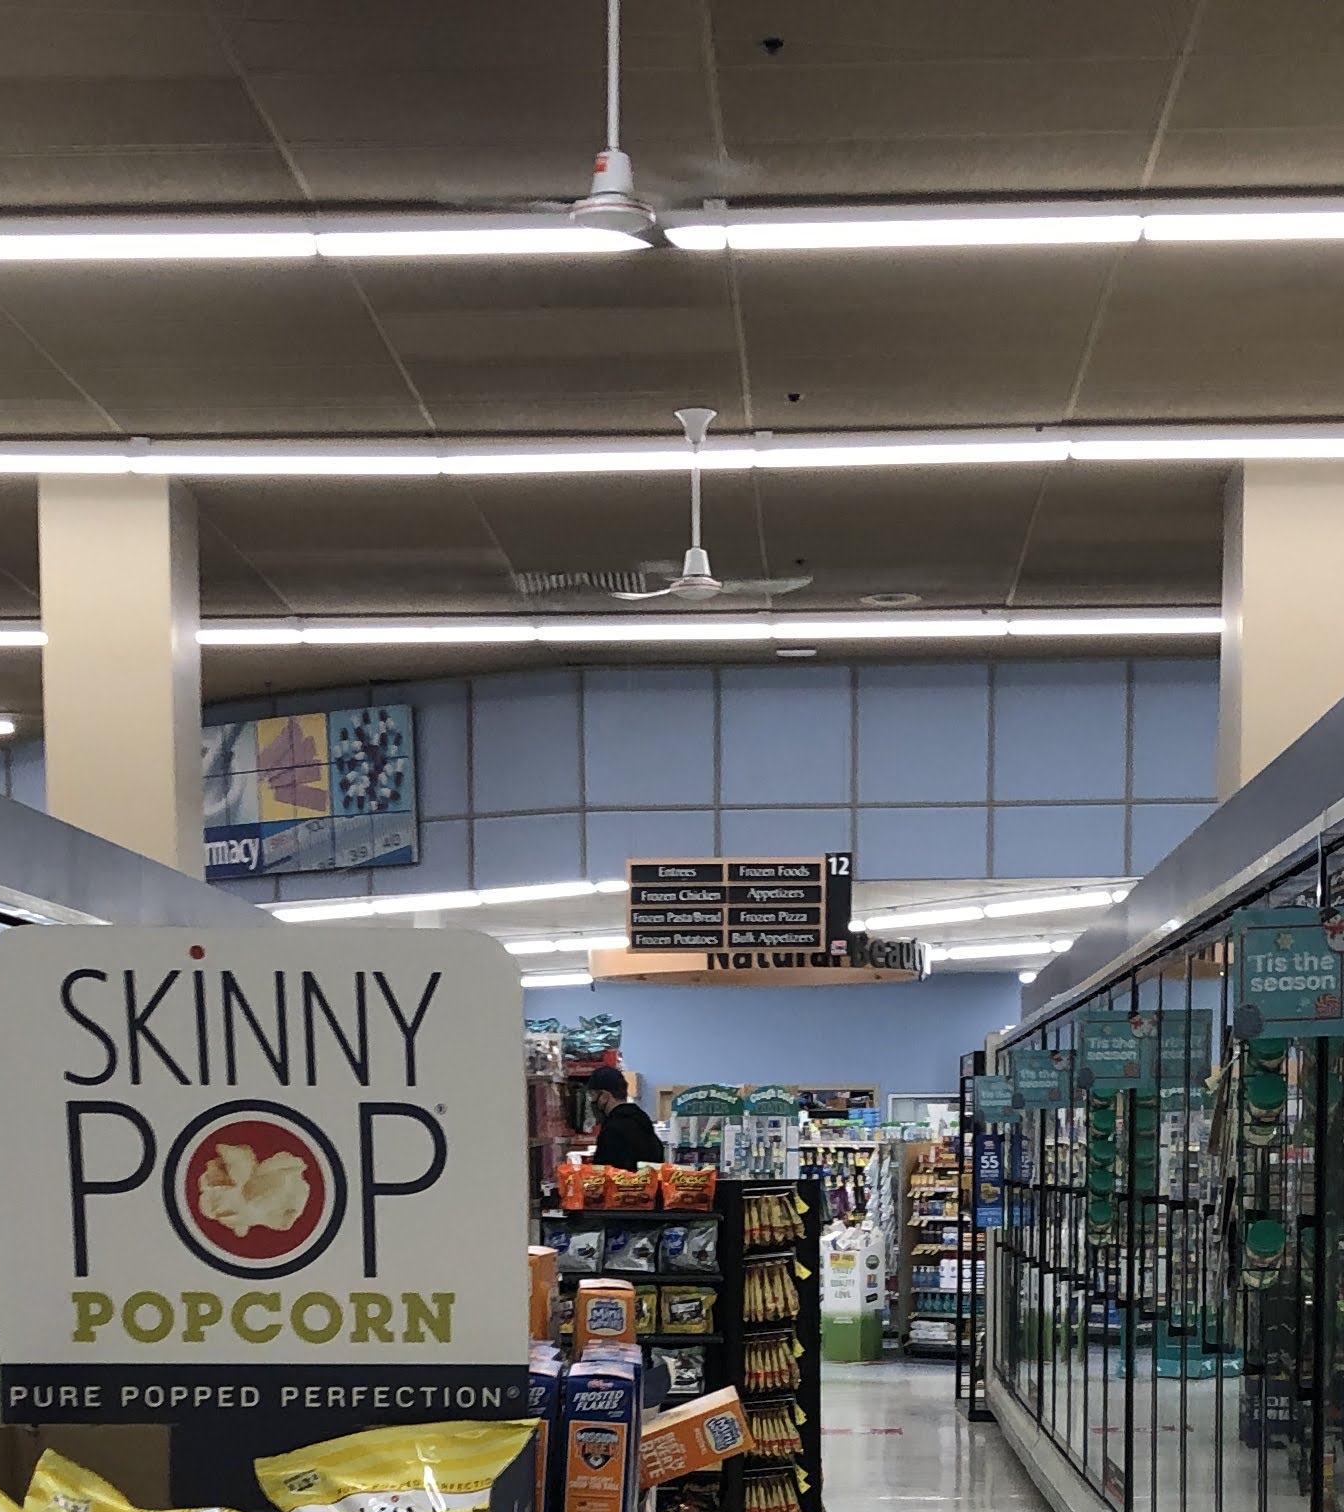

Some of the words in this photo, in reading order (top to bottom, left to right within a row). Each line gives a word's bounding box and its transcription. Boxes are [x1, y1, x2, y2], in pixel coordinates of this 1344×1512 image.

[739, 865, 775, 877] Frozen
[778, 865, 810, 877] Foods
[828, 857, 850, 876] 12
[641, 890, 676, 901] Frozen
[679, 890, 722, 901] Chicken
[747, 888, 805, 902] Appetizers
[633, 912, 665, 923] Frozen
[740, 912, 776, 922] Frozen
[778, 911, 807, 922] Pizza
[636, 934, 671, 945] Frozen
[674, 933, 719, 944] Potatoes
[758, 932, 815, 945] Appetizers
[1293, 952, 1335, 971] the
[1250, 974, 1336, 993] season
[65, 1098, 448, 1281] POP
[71, 1290, 456, 1345] POPCORN
[10, 1385, 101, 1408] PURE
[120, 1385, 260, 1408] POPPED
[573, 1389, 625, 1403] FROSTED
[575, 1400, 620, 1412] FLAKES
